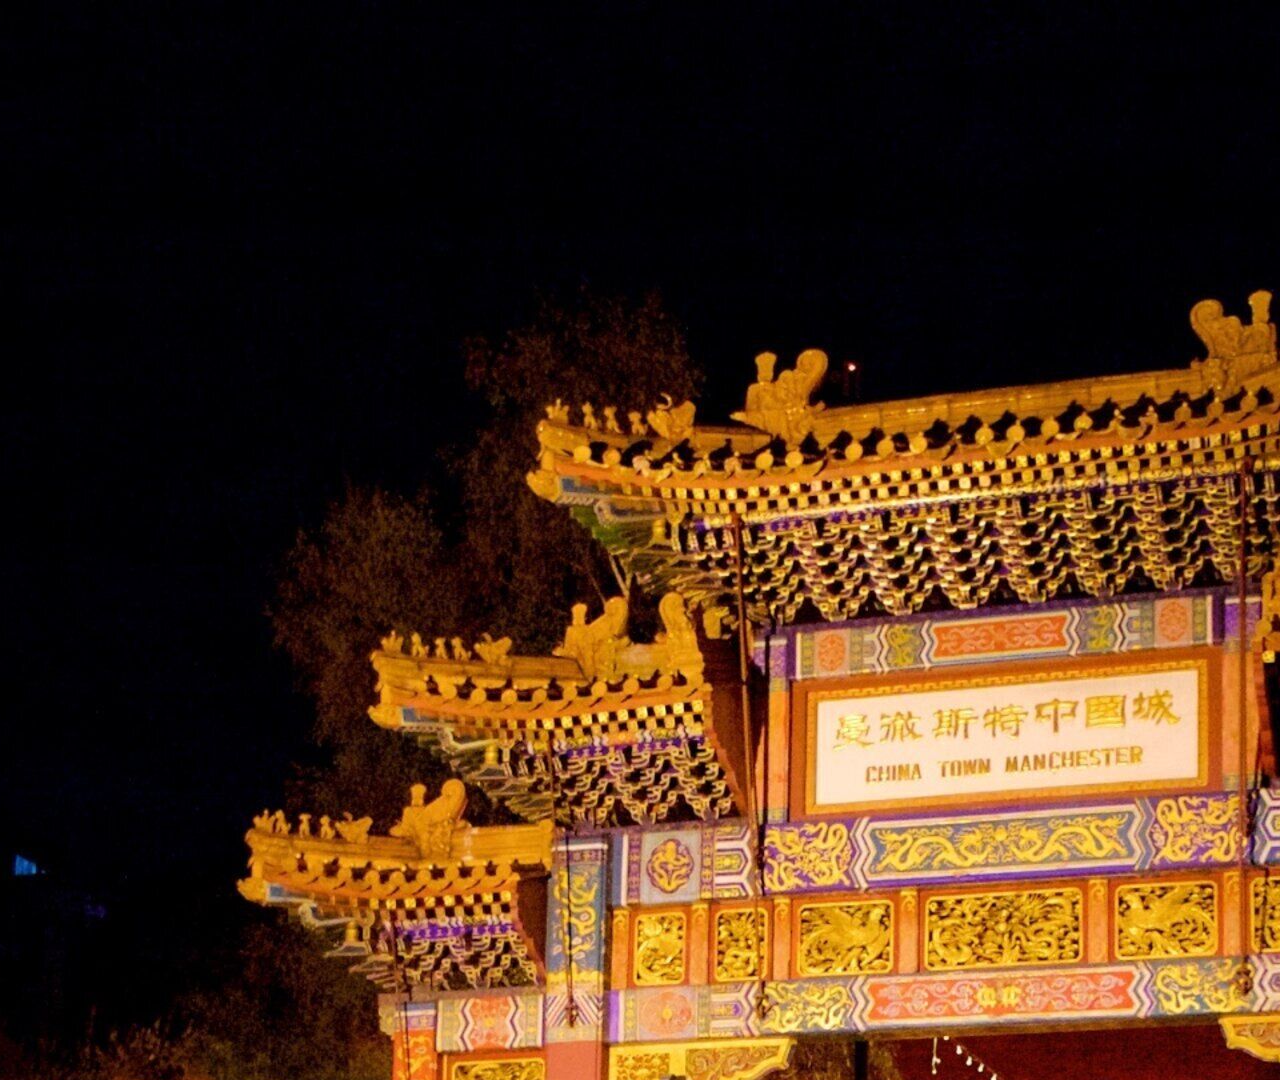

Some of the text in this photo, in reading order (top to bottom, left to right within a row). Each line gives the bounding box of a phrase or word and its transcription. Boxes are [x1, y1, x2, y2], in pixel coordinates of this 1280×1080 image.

[833, 689, 1181, 751] 曼徹斯特中國城
[864, 745, 1144, 783] CHINA TOWN MANCHESTER
